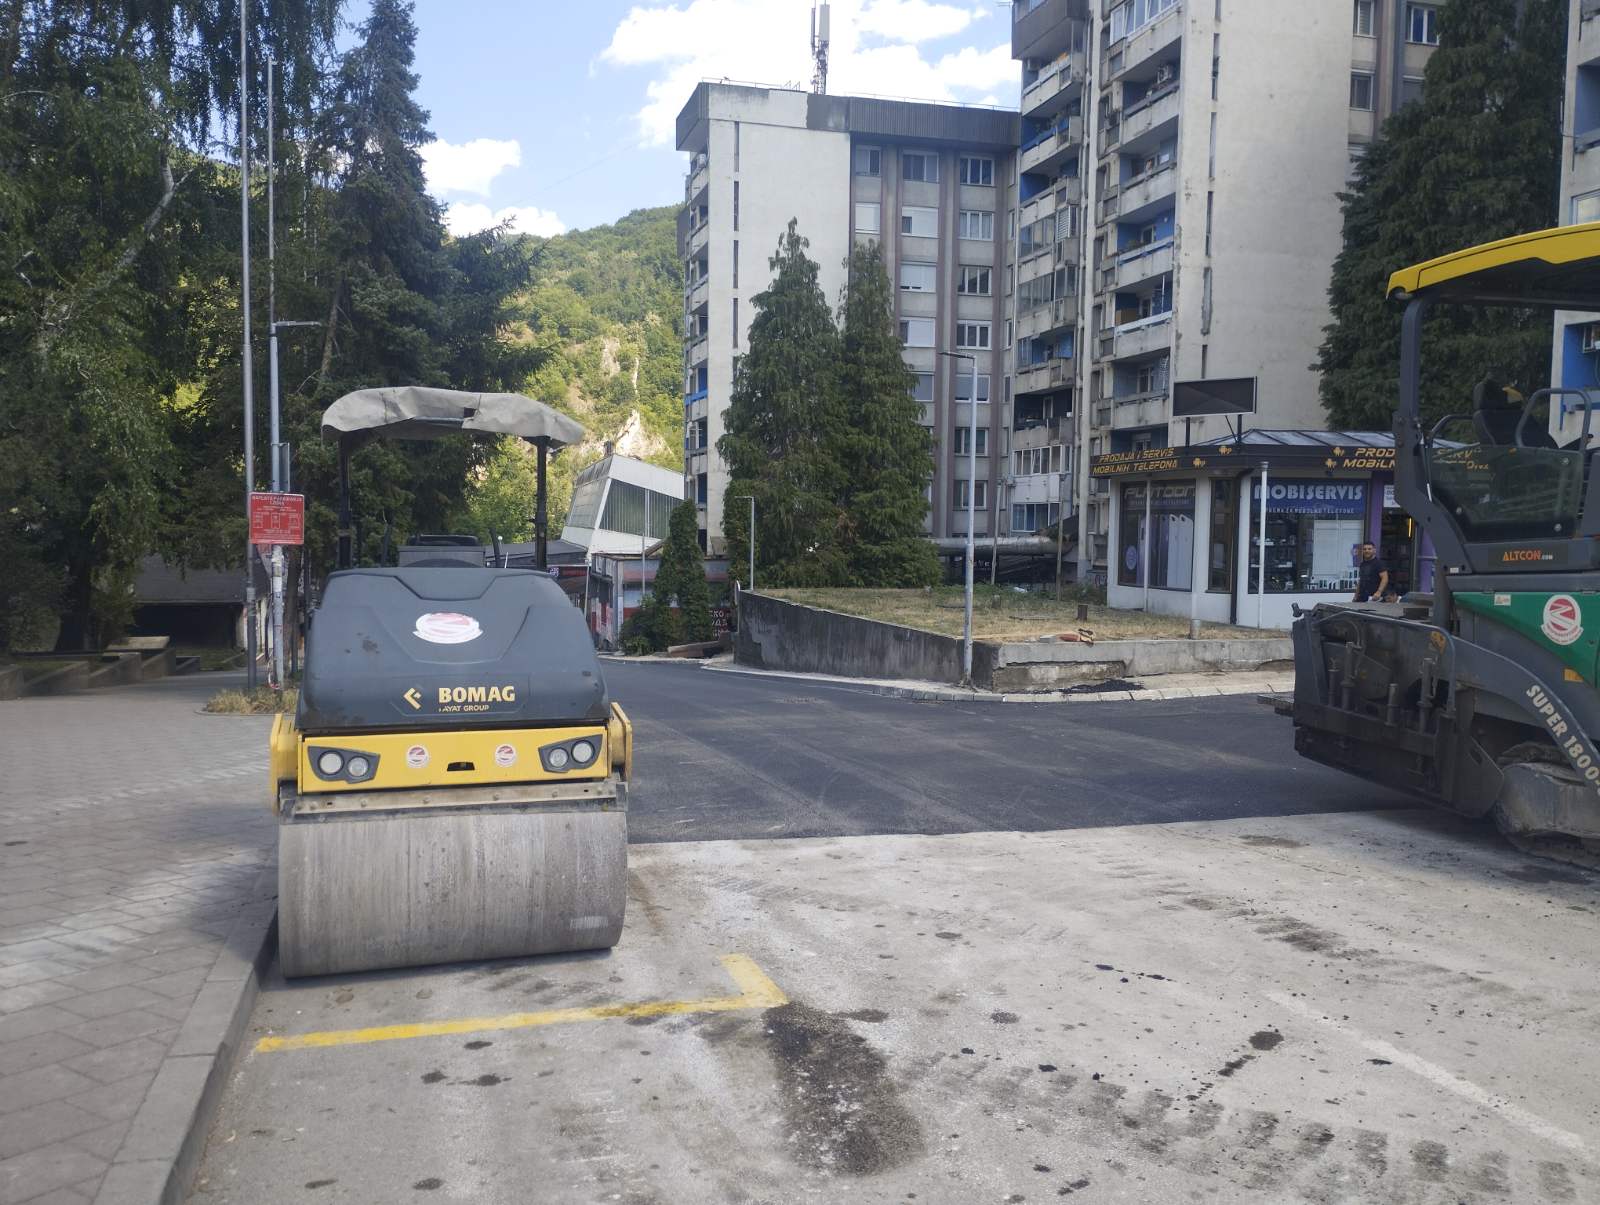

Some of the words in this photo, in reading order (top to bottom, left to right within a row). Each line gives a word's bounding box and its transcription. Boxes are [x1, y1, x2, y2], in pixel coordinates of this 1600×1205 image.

[1098, 452, 1135, 463] PRODAJA
[1133, 459, 1178, 471] TELEFONA
[1254, 484, 1363, 500] MOBISERVIS
[438, 685, 516, 704] BOMAG
[463, 704, 490, 712] GROUP
[1526, 684, 1568, 738] SUPER
